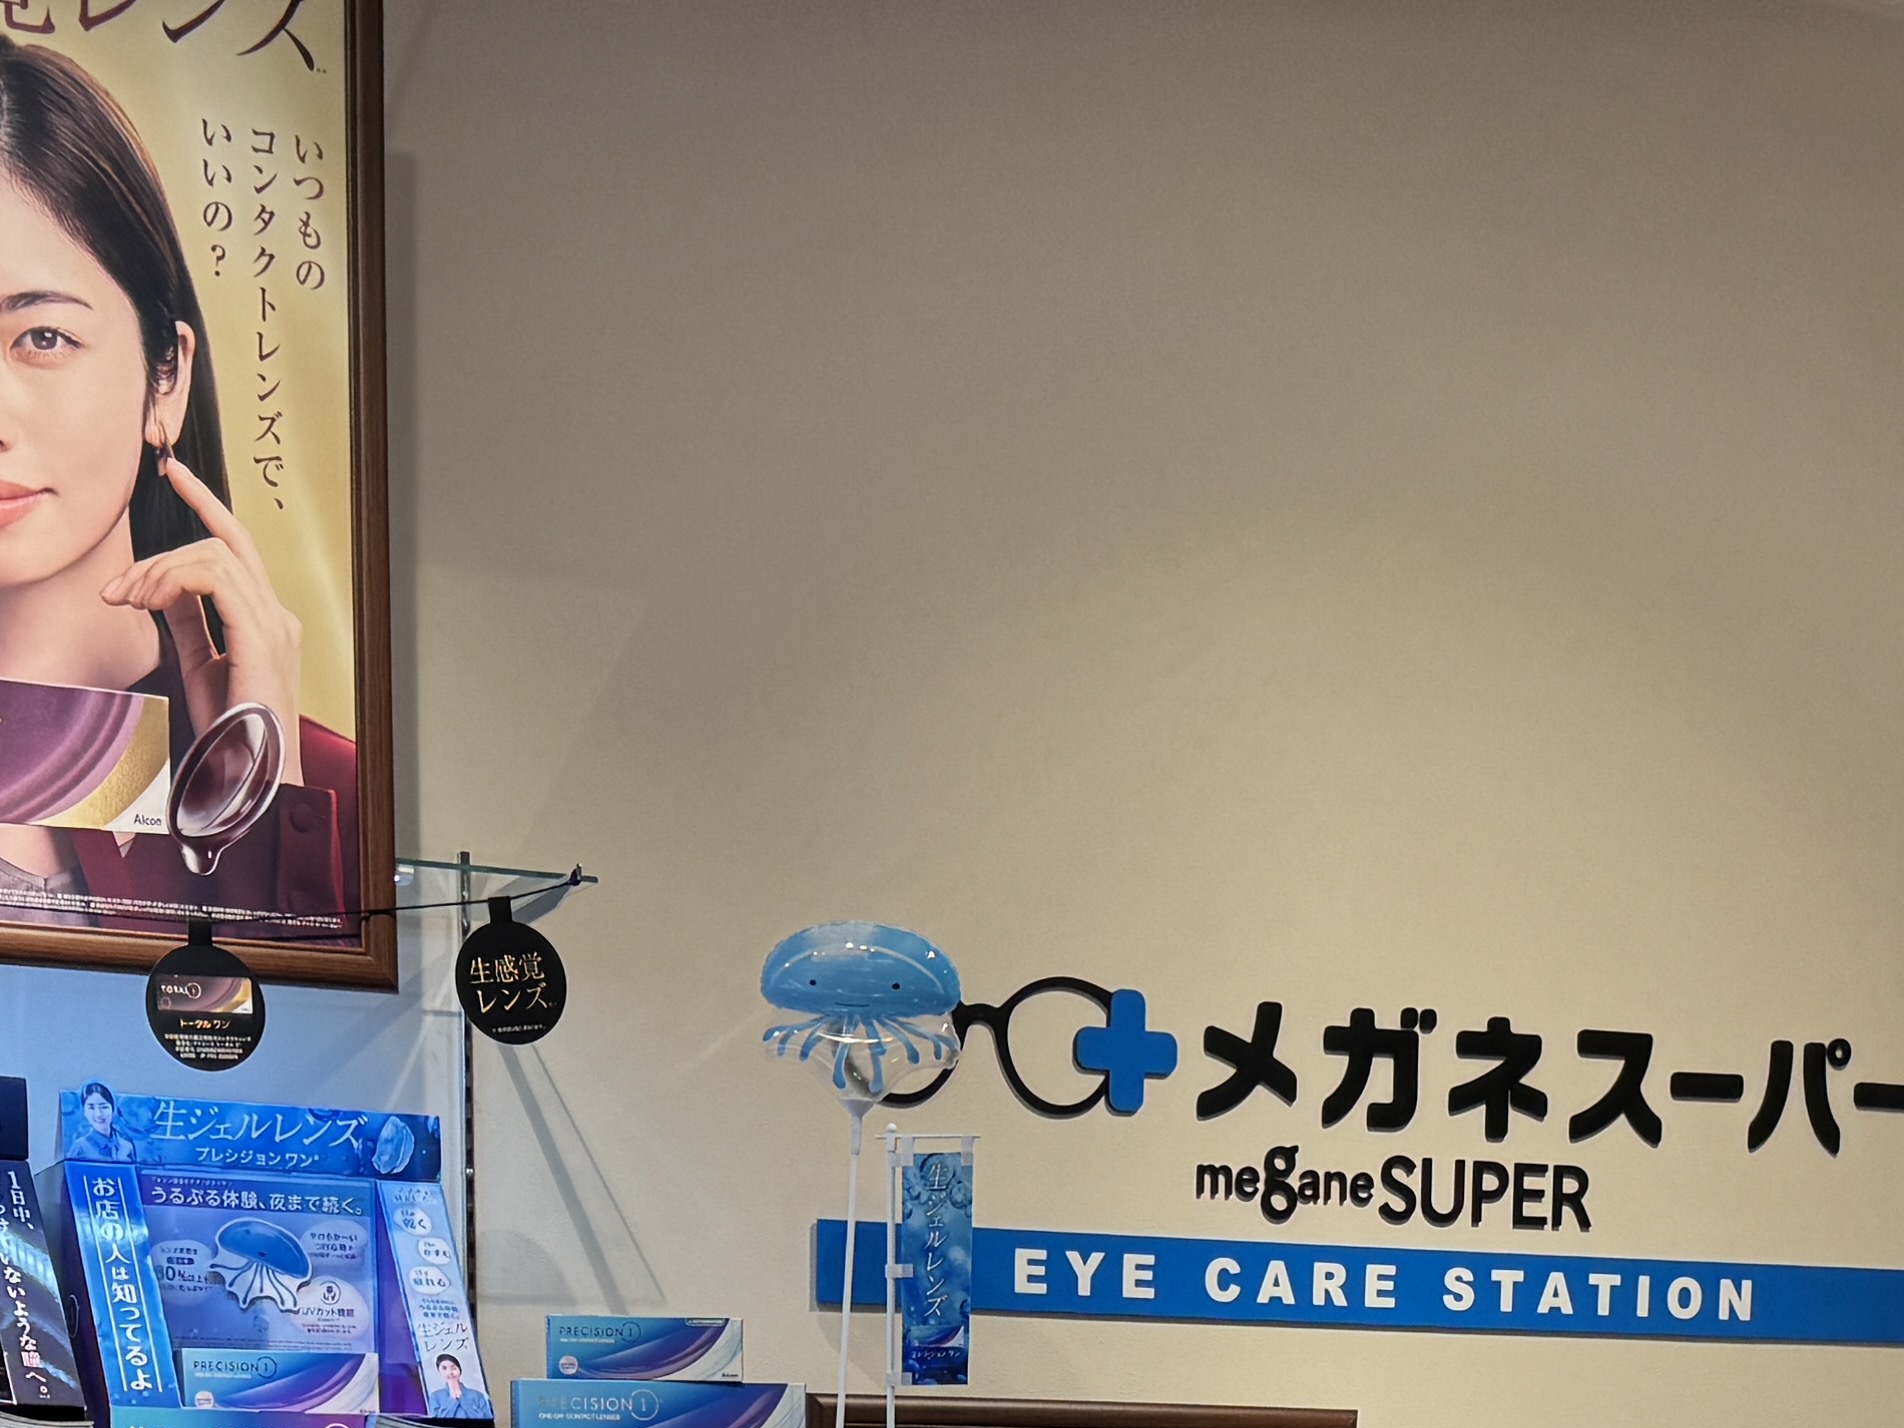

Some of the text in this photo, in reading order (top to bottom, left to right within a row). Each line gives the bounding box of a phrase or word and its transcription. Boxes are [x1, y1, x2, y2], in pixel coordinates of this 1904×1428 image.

[202, 117, 233, 277] いいの？
[294, 134, 326, 291] いつもの
[249, 127, 292, 511] コンタクトレンズで、
[133, 813, 163, 828] Alcon
[469, 952, 543, 985] 生感覚
[475, 980, 548, 1013] レンズ
[151, 1100, 369, 1149] 生ジェルレンズ
[194, 1146, 282, 1168] プレシジョン
[150, 1185, 364, 1217] うるぷる体験、夜まで続く。
[923, 1163, 948, 1318] 生ジェルレンズ
[91, 1175, 155, 1393] お店の人は知ってるよ
[1013, 1248, 1755, 1323] EYE CARE STATION
